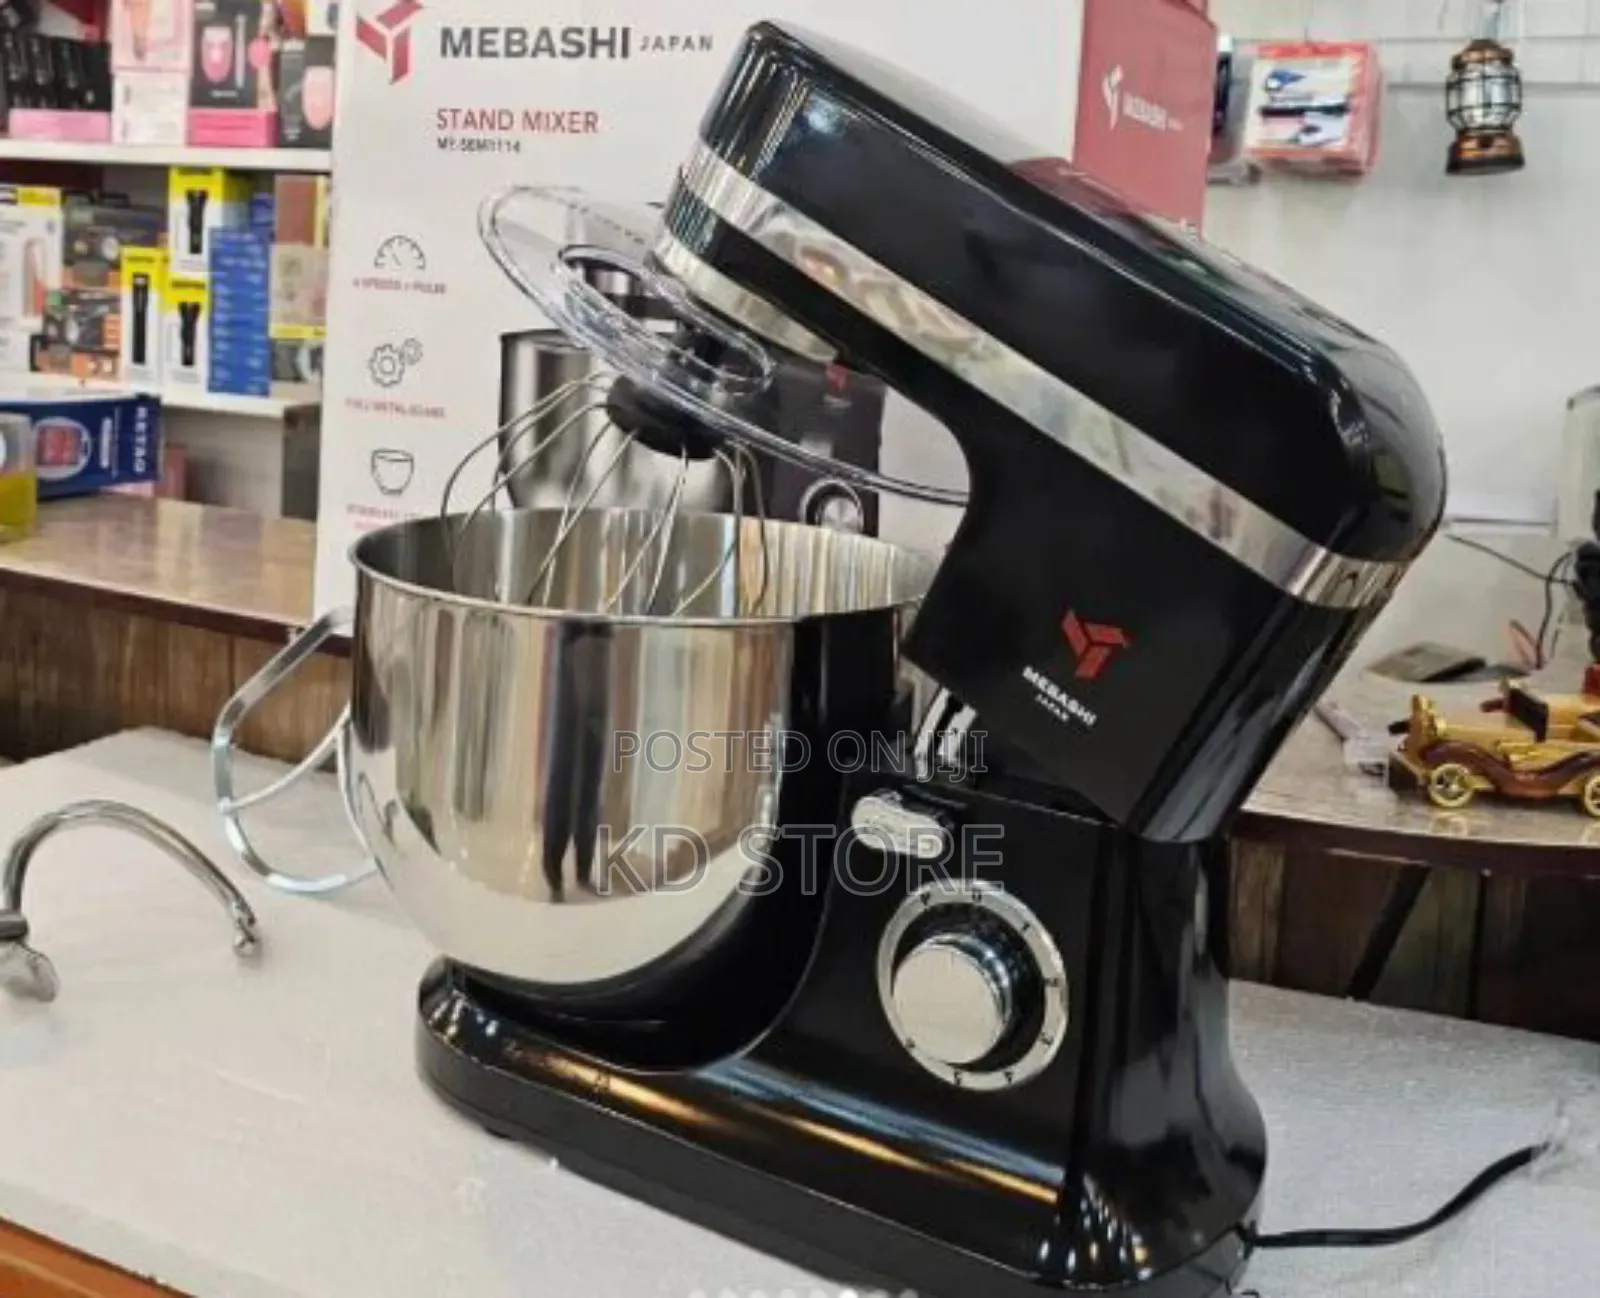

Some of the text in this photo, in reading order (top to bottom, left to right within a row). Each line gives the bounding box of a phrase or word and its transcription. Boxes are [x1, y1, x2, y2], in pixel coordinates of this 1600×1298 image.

[440, 27, 713, 59] MEBASHI JAPAN
[437, 109, 599, 134] STAND MIXER
